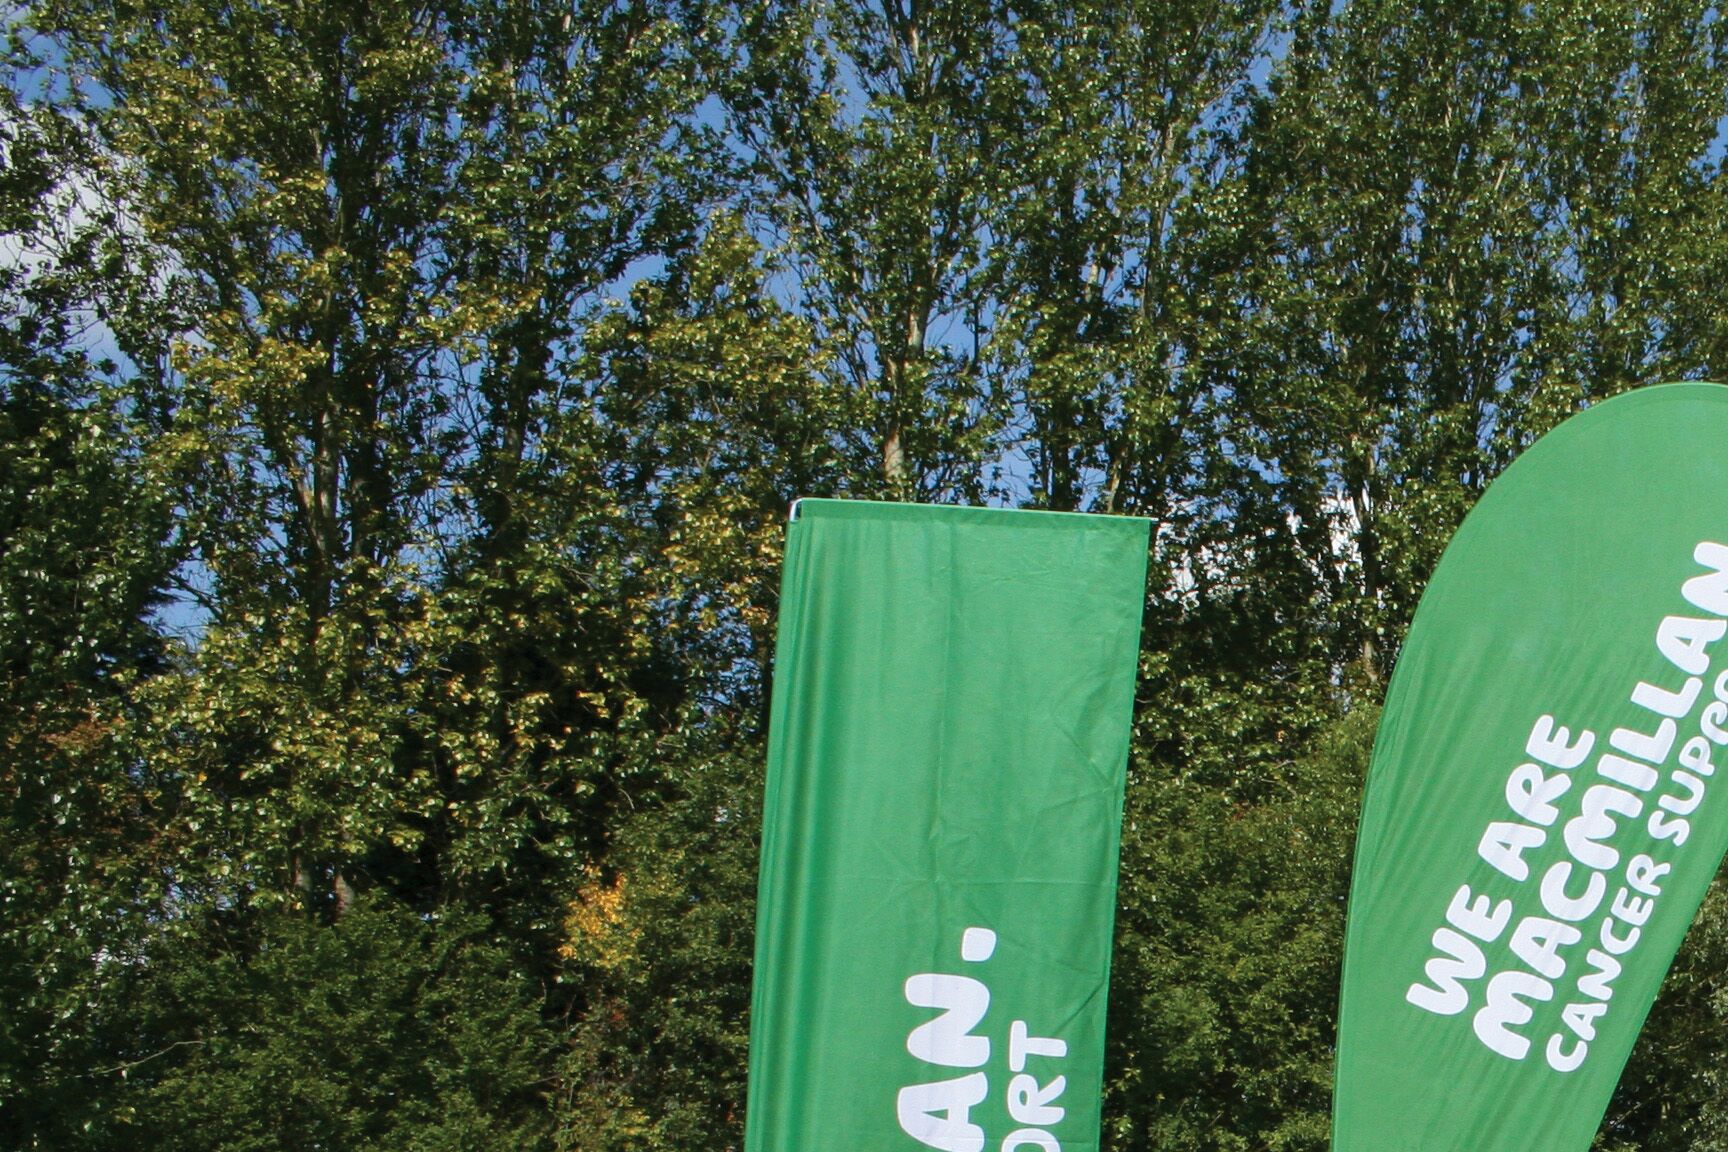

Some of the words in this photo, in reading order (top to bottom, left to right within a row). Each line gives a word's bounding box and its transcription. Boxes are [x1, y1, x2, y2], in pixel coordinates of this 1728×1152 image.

[1405, 884, 1513, 1015] WE
[1477, 714, 1596, 881] ARE
[1546, 853, 1671, 1072] CANCER
